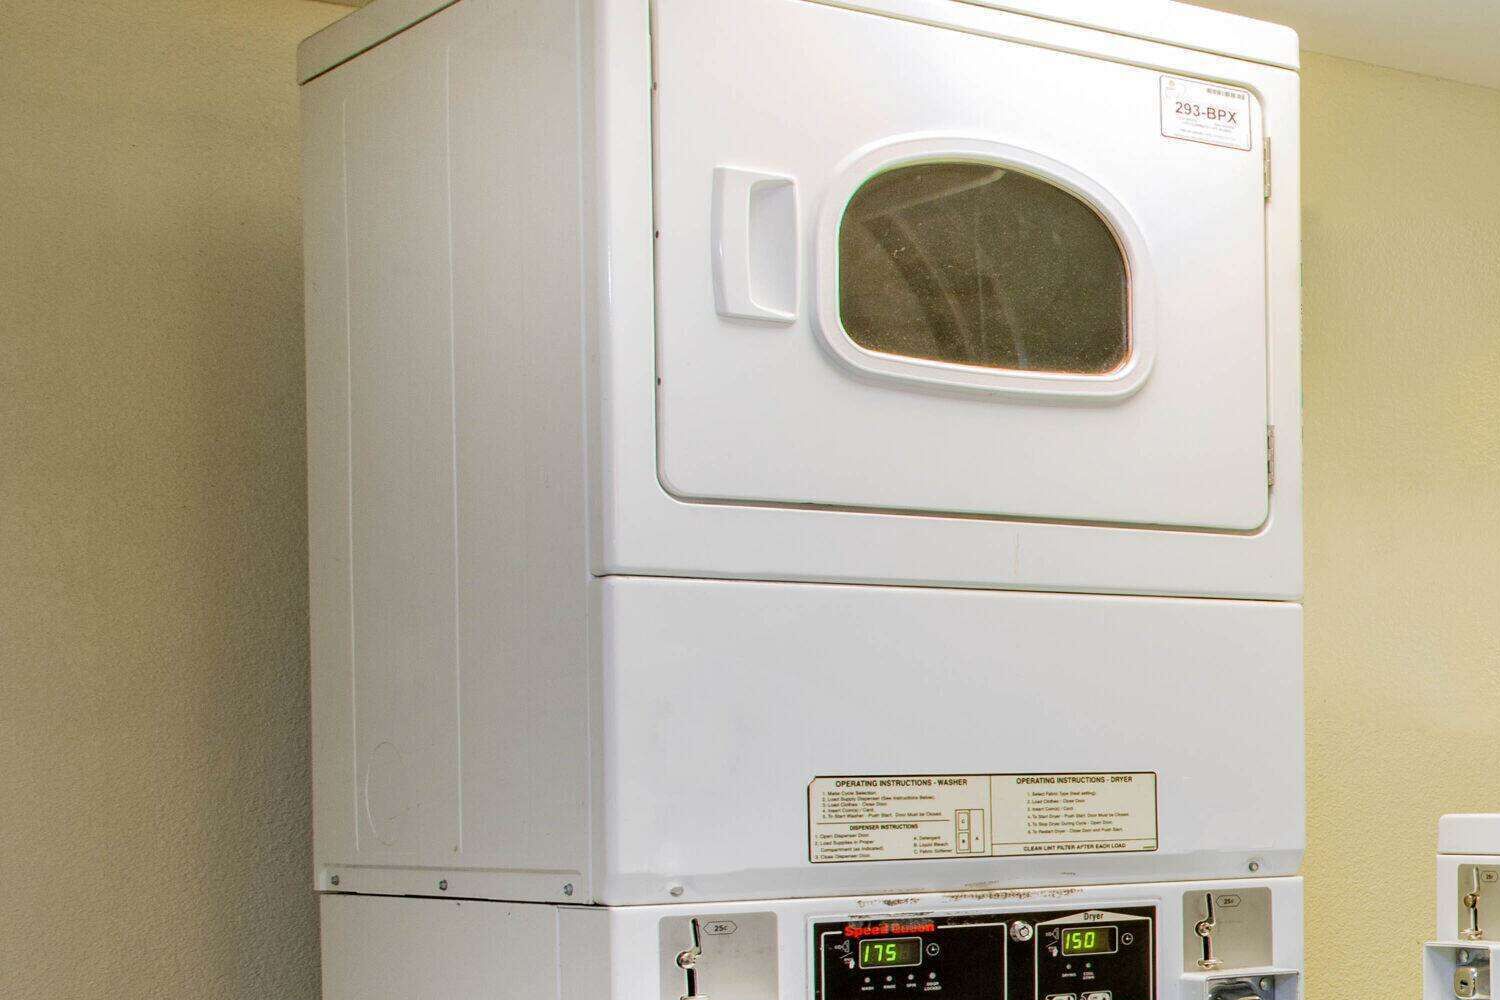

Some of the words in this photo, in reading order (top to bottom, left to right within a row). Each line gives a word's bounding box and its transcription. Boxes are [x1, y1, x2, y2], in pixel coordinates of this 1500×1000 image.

[1176, 101, 1237, 124] 293-BPX
[879, 779, 932, 787] INSTRUCTIONS
[1056, 776, 1105, 784] INSTRUCTIONS
[1084, 912, 1104, 921] Dryer
[1065, 931, 1095, 950] 150
[863, 943, 897, 963] 175
